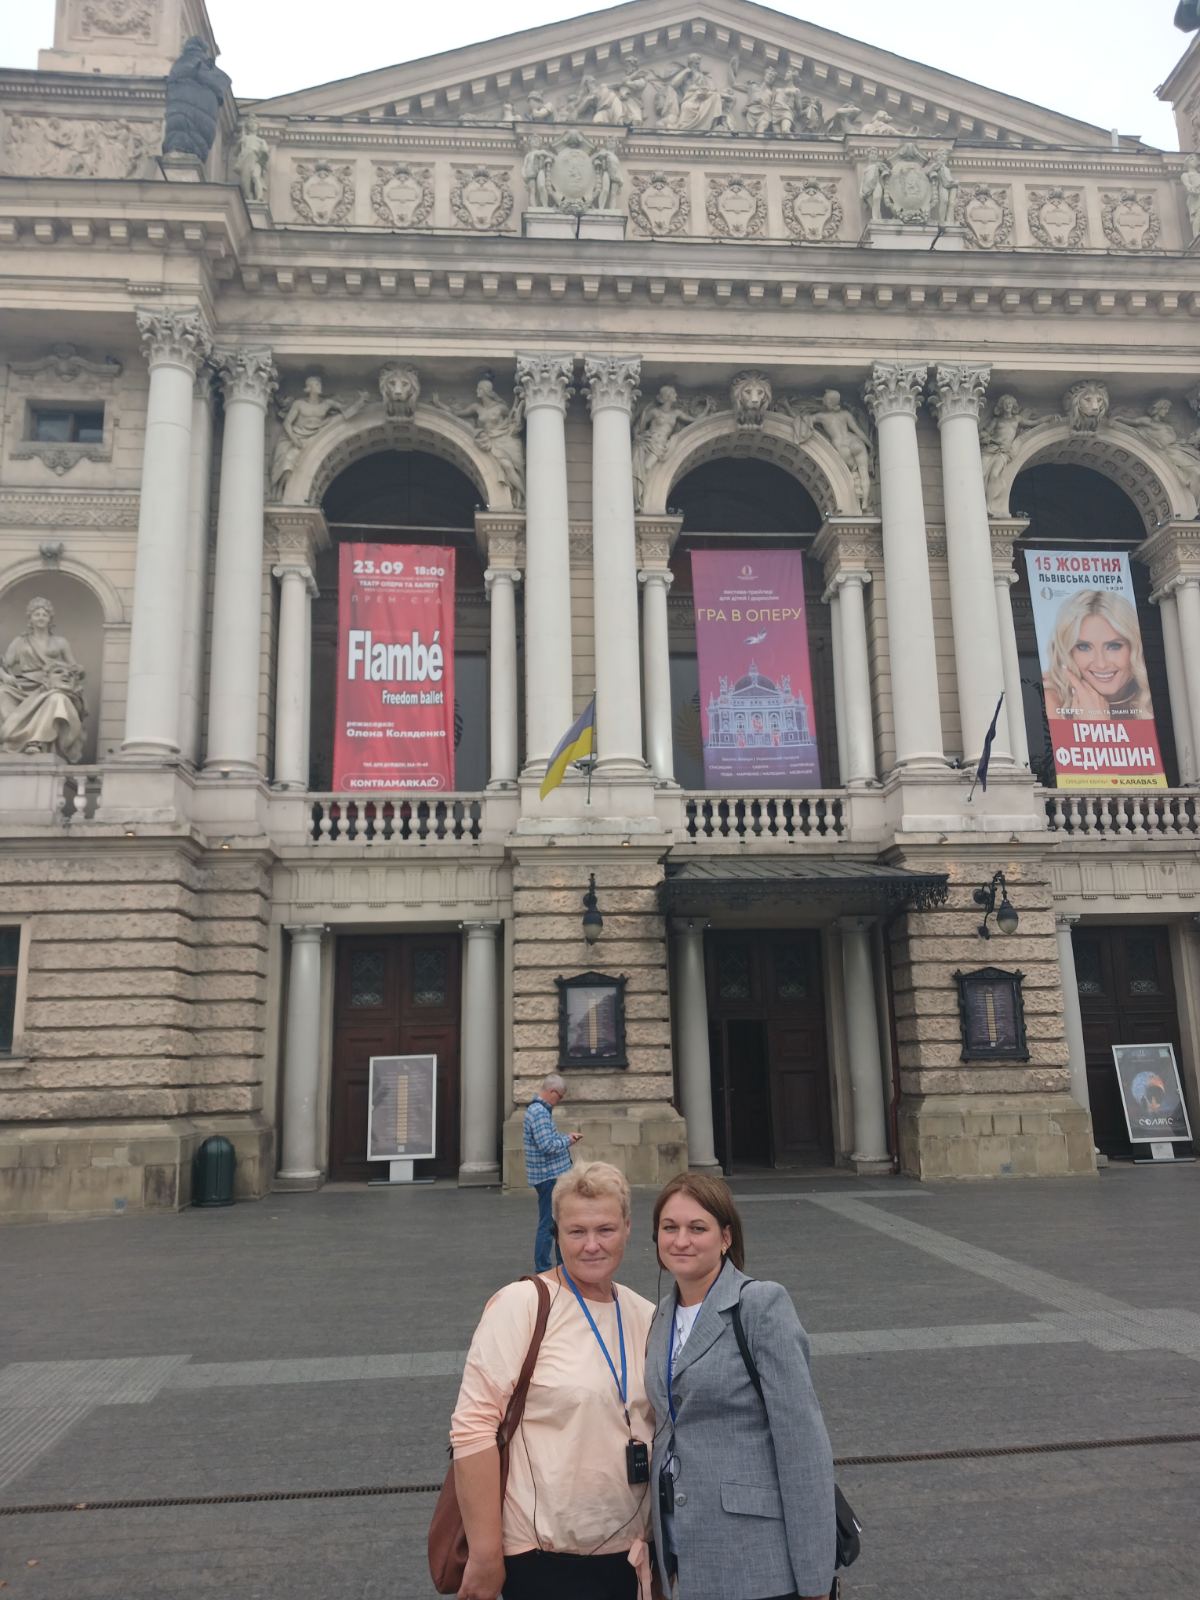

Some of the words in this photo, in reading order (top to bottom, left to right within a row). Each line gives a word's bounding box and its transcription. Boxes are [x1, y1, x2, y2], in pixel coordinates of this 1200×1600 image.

[353, 560, 404, 574] 23.09
[414, 565, 445, 576] 18:00
[1035, 556, 1051, 571] 15
[1056, 556, 1122, 572] ЖОВТНЯ
[1039, 573, 1090, 583] ЛЬВІВСЬКА
[1092, 574, 1123, 584] ОПЕРА
[697, 608, 727, 621] ГРА
[731, 609, 742, 621] В
[745, 607, 802, 622] ОПЕРУ
[347, 630, 443, 681] Flambé
[382, 690, 418, 705] Freedom
[420, 690, 443, 705] ballet
[346, 728, 383, 738] Олена
[386, 728, 446, 739] Коляденко
[1072, 722, 1130, 743] ІРИНА
[1055, 746, 1156, 770] ФЕДИШИН
[350, 778, 428, 787] KONTRAMARKA
